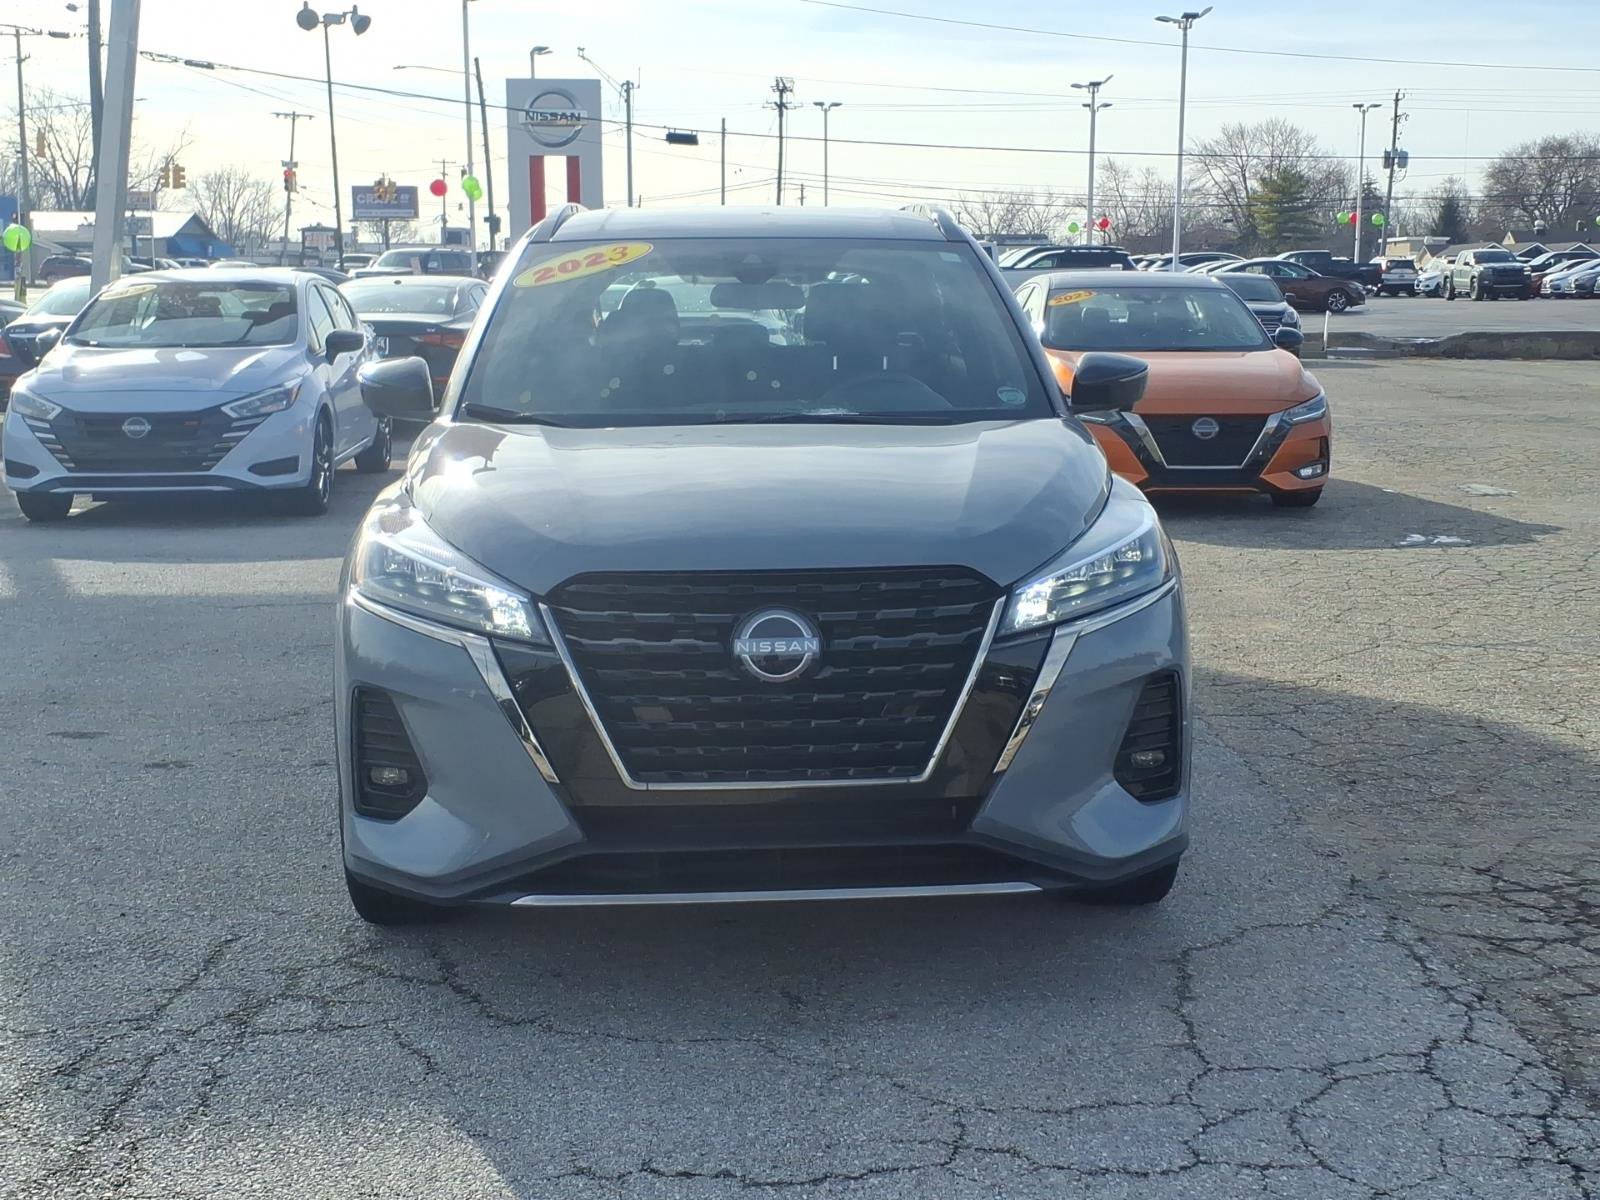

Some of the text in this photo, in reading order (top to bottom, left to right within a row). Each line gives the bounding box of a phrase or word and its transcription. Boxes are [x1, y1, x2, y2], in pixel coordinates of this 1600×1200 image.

[525, 111, 581, 121] NISSAN
[533, 246, 629, 284] 2023
[736, 640, 817, 653] NISSAN
